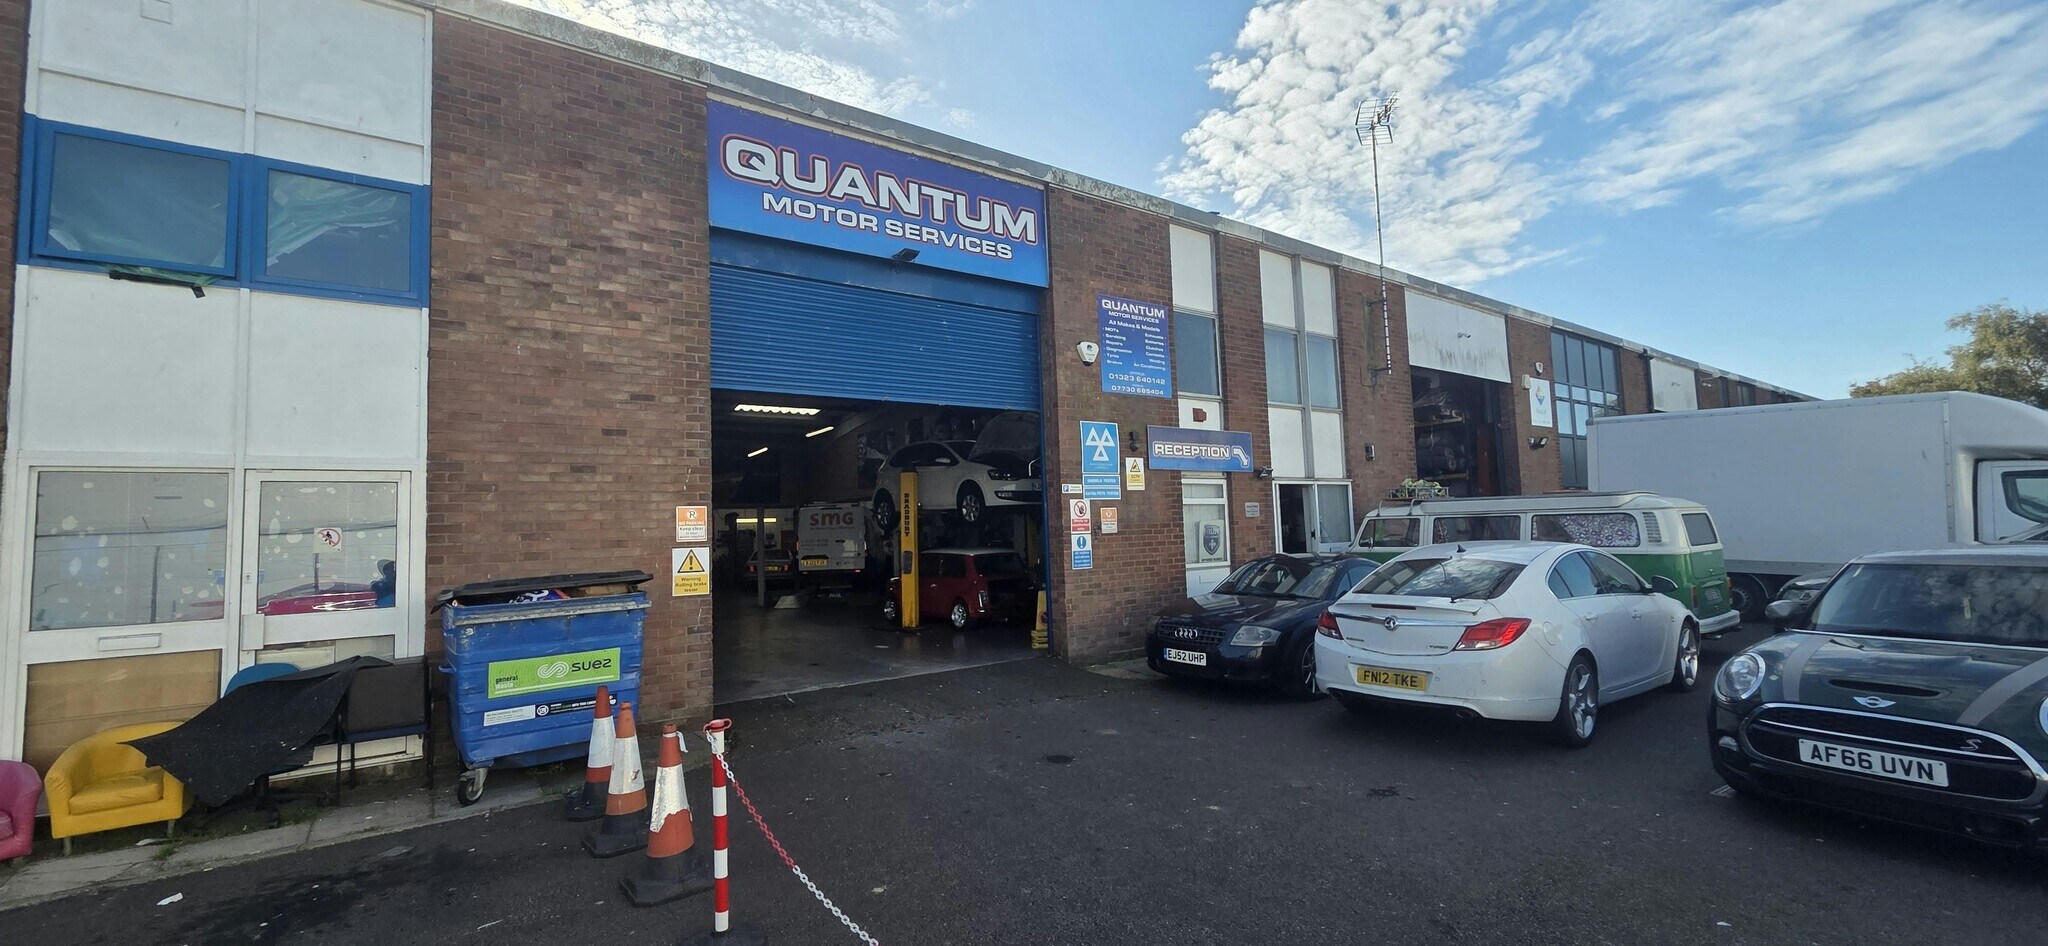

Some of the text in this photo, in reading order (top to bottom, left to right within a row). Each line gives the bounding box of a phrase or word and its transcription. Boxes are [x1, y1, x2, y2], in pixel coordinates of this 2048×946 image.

[723, 136, 1037, 244] QUANTUM
[763, 193, 1013, 259] MOTOR SERVICES
[1102, 299, 1164, 318] QUANTUM
[1131, 315, 1159, 323] SERVICES
[1109, 373, 1165, 384] 01323 640142
[1154, 443, 1230, 458] RECEPTION
[1168, 650, 1204, 662] EJ52 UHP
[572, 658, 612, 672] suez
[495, 675, 518, 684] general
[1364, 671, 1418, 687] FN12 TKE
[1811, 744, 1934, 781] AF66 UVN
